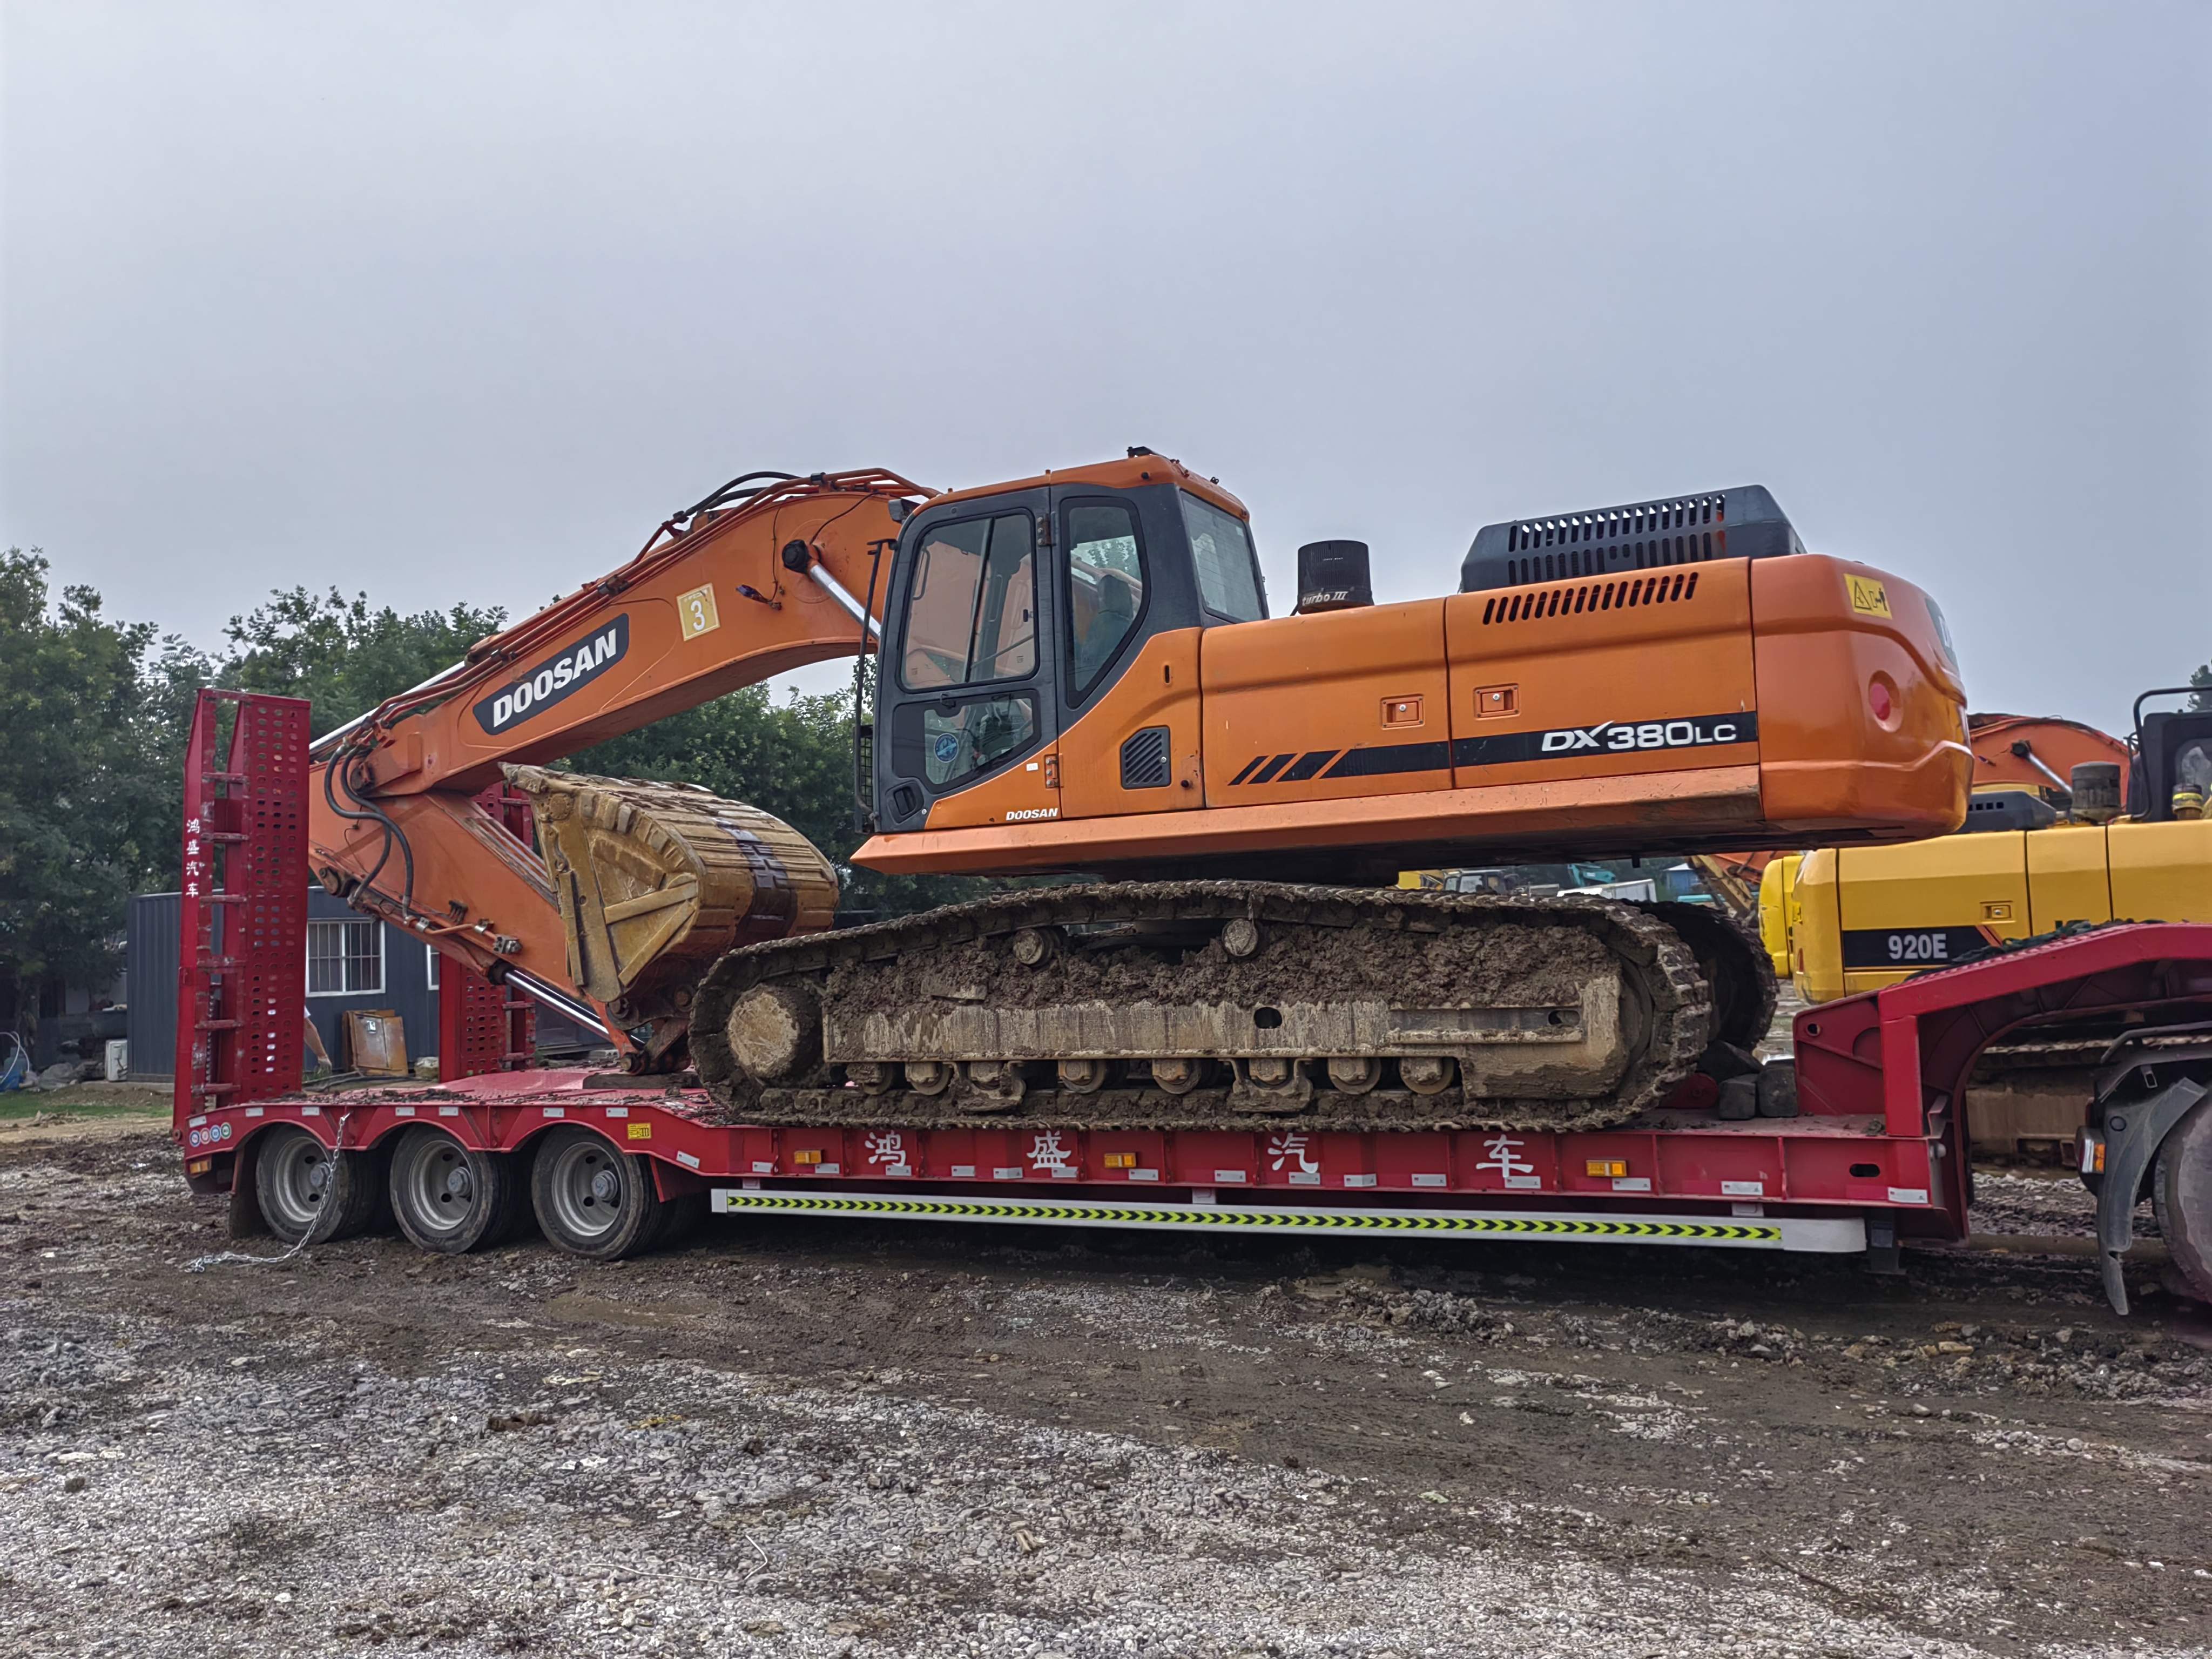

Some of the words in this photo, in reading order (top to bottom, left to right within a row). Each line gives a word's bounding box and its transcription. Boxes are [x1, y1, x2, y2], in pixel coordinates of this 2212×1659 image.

[1302, 592, 1330, 606] turbo
[1331, 591, 1348, 601] III
[691, 600, 705, 631] 3
[494, 628, 616, 727] DOOSAN
[1006, 808, 1058, 820] DOOSAN
[186, 818, 200, 899] 鸿盛汽车
[1889, 933, 1948, 960] 920E
[865, 1130, 1534, 1179] 鸿盛汽车
